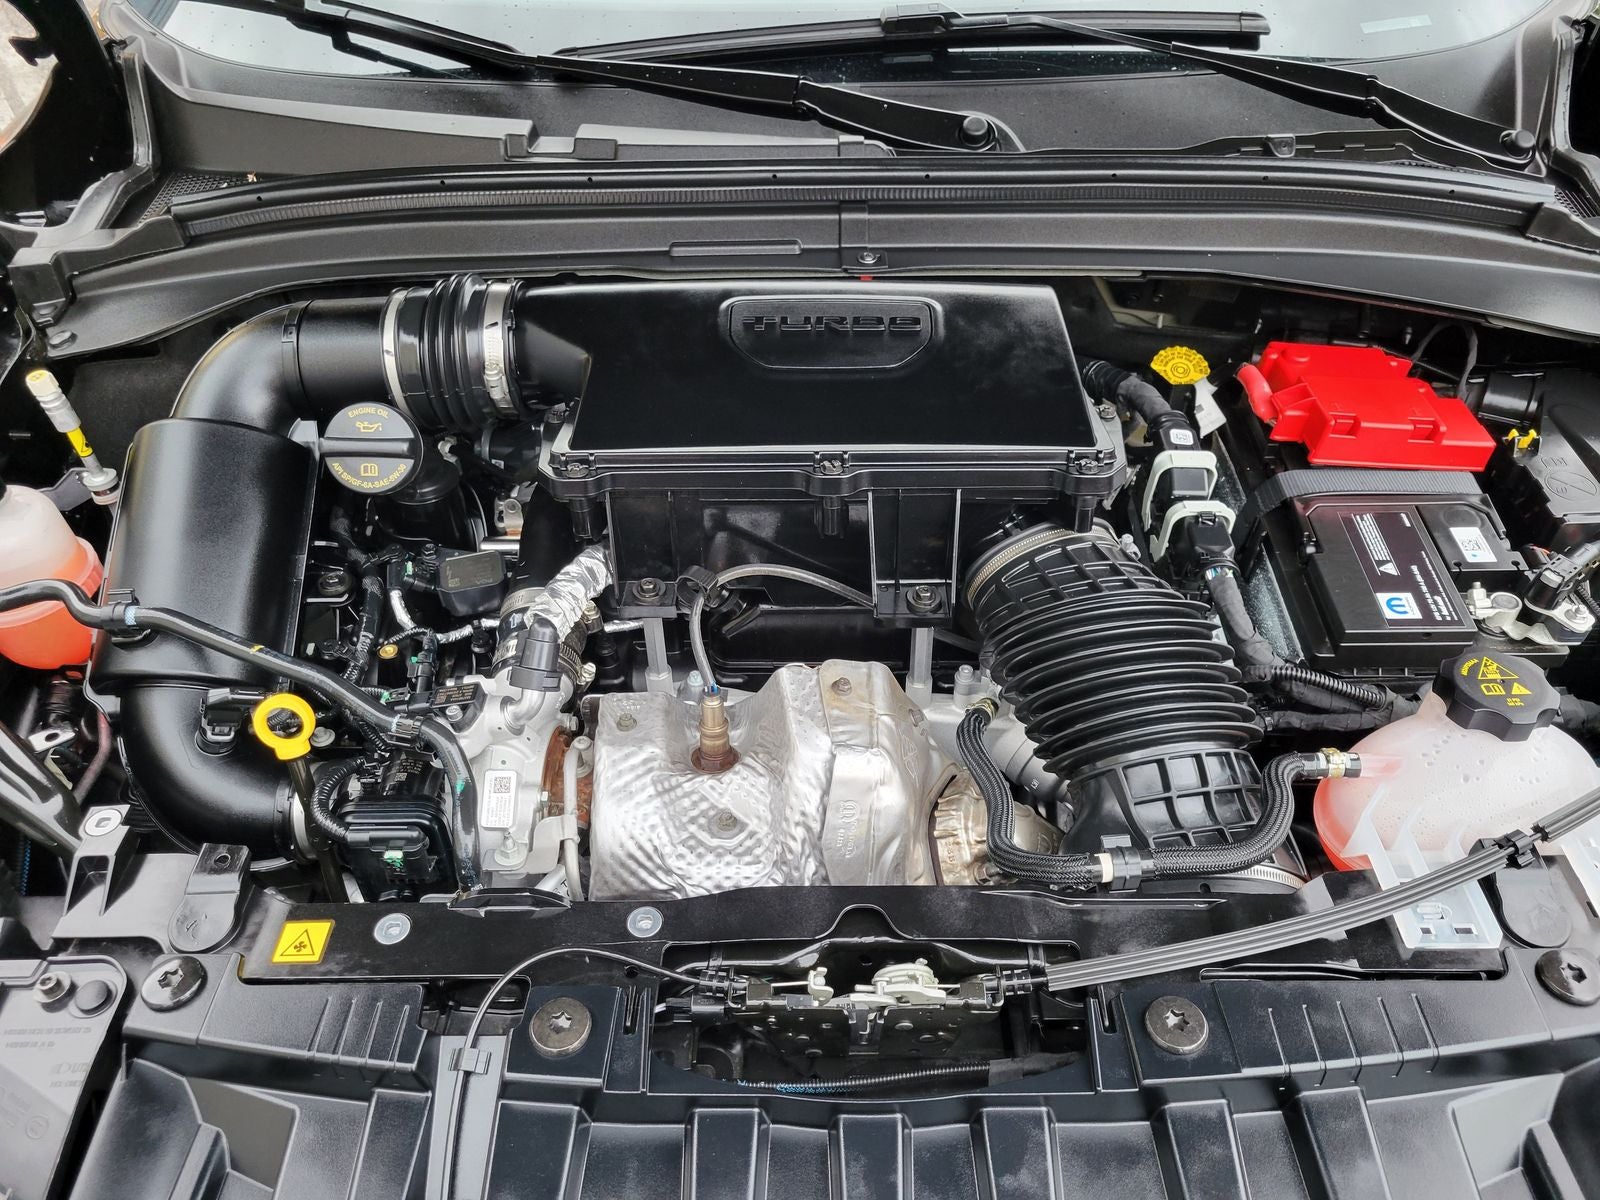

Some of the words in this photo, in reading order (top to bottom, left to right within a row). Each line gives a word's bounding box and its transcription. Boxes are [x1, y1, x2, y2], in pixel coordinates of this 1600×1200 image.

[347, 407, 377, 418] ENGINE
[377, 408, 390, 419] OIL
[331, 462, 343, 476] API
